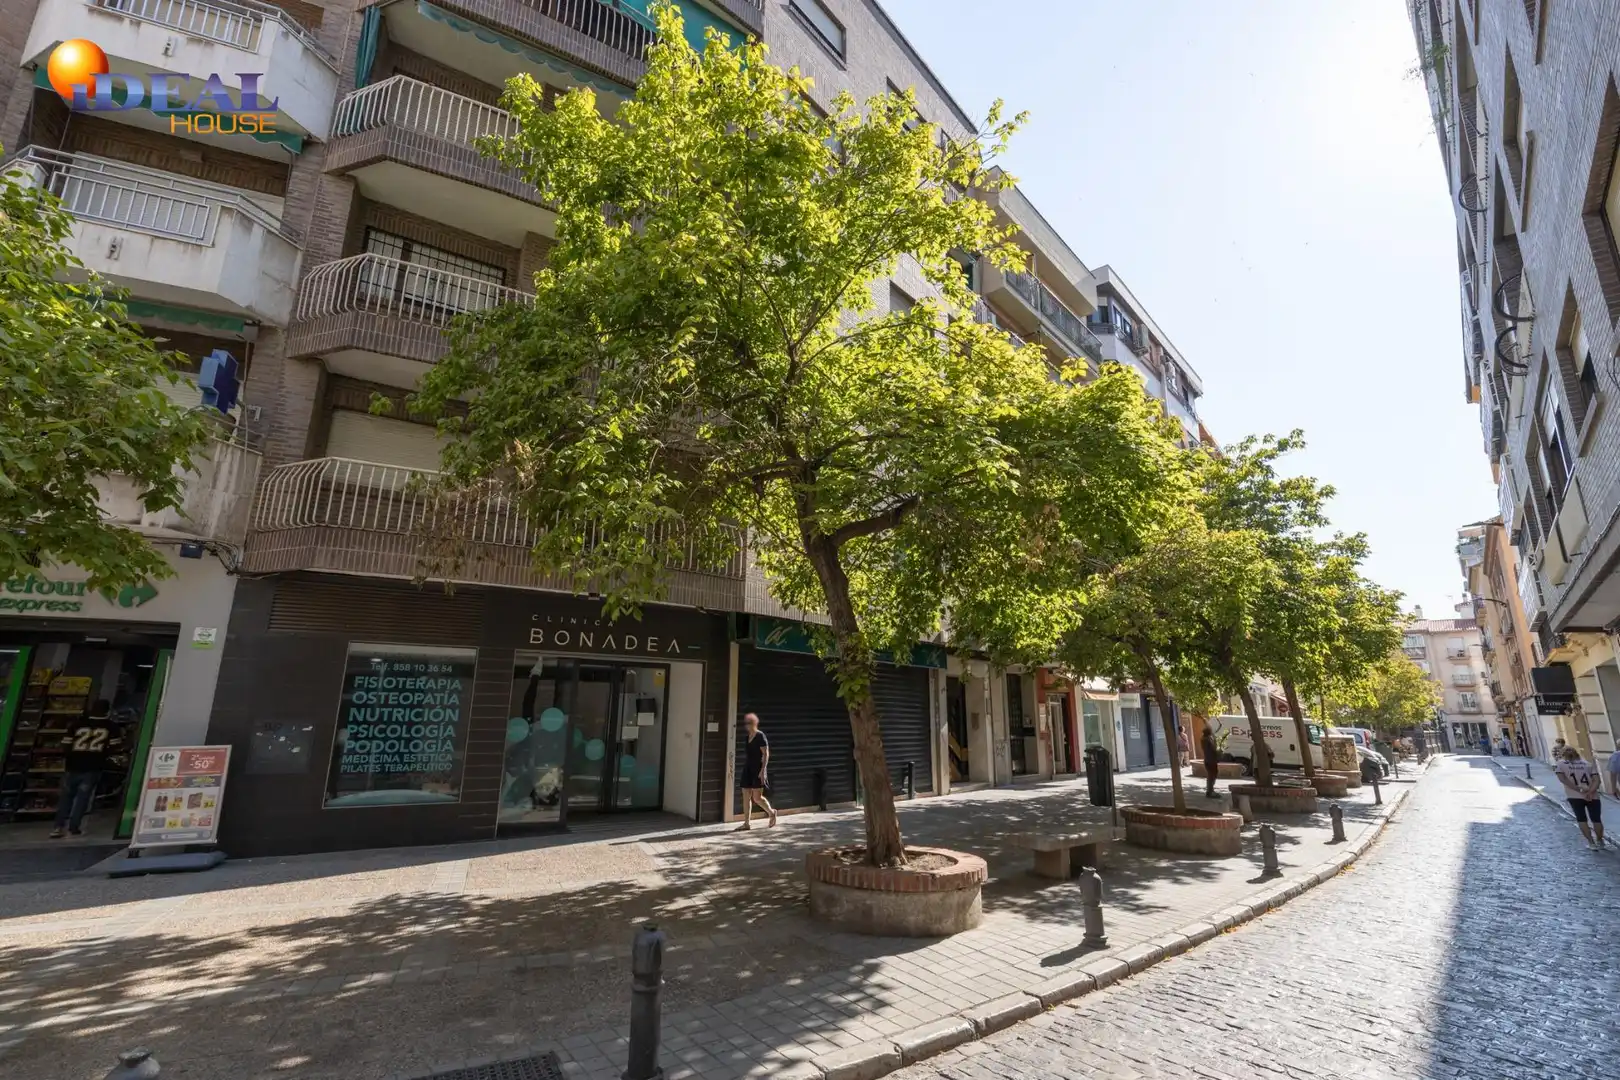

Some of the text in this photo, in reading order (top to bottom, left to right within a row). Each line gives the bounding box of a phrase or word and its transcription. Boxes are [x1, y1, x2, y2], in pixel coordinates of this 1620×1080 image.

[0, 598, 83, 613] express
[531, 614, 614, 627] CLINICA
[530, 628, 681, 653] BONADEA
[393, 664, 411, 672] 858
[414, 664, 426, 672] 10
[353, 676, 462, 690] FISIOTERAPIA
[352, 690, 460, 705] OSTEOPATÍA
[348, 706, 460, 722] NUTRICIÓN
[347, 722, 456, 738] PSICOLOGÍA
[1231, 726, 1283, 739] Expess
[72, 727, 109, 752] 22
[343, 737, 454, 753] PODOLOGÍA
[342, 754, 400, 763] MEDICINA
[340, 764, 381, 773] PILATES
[1570, 773, 1589, 786] 14
